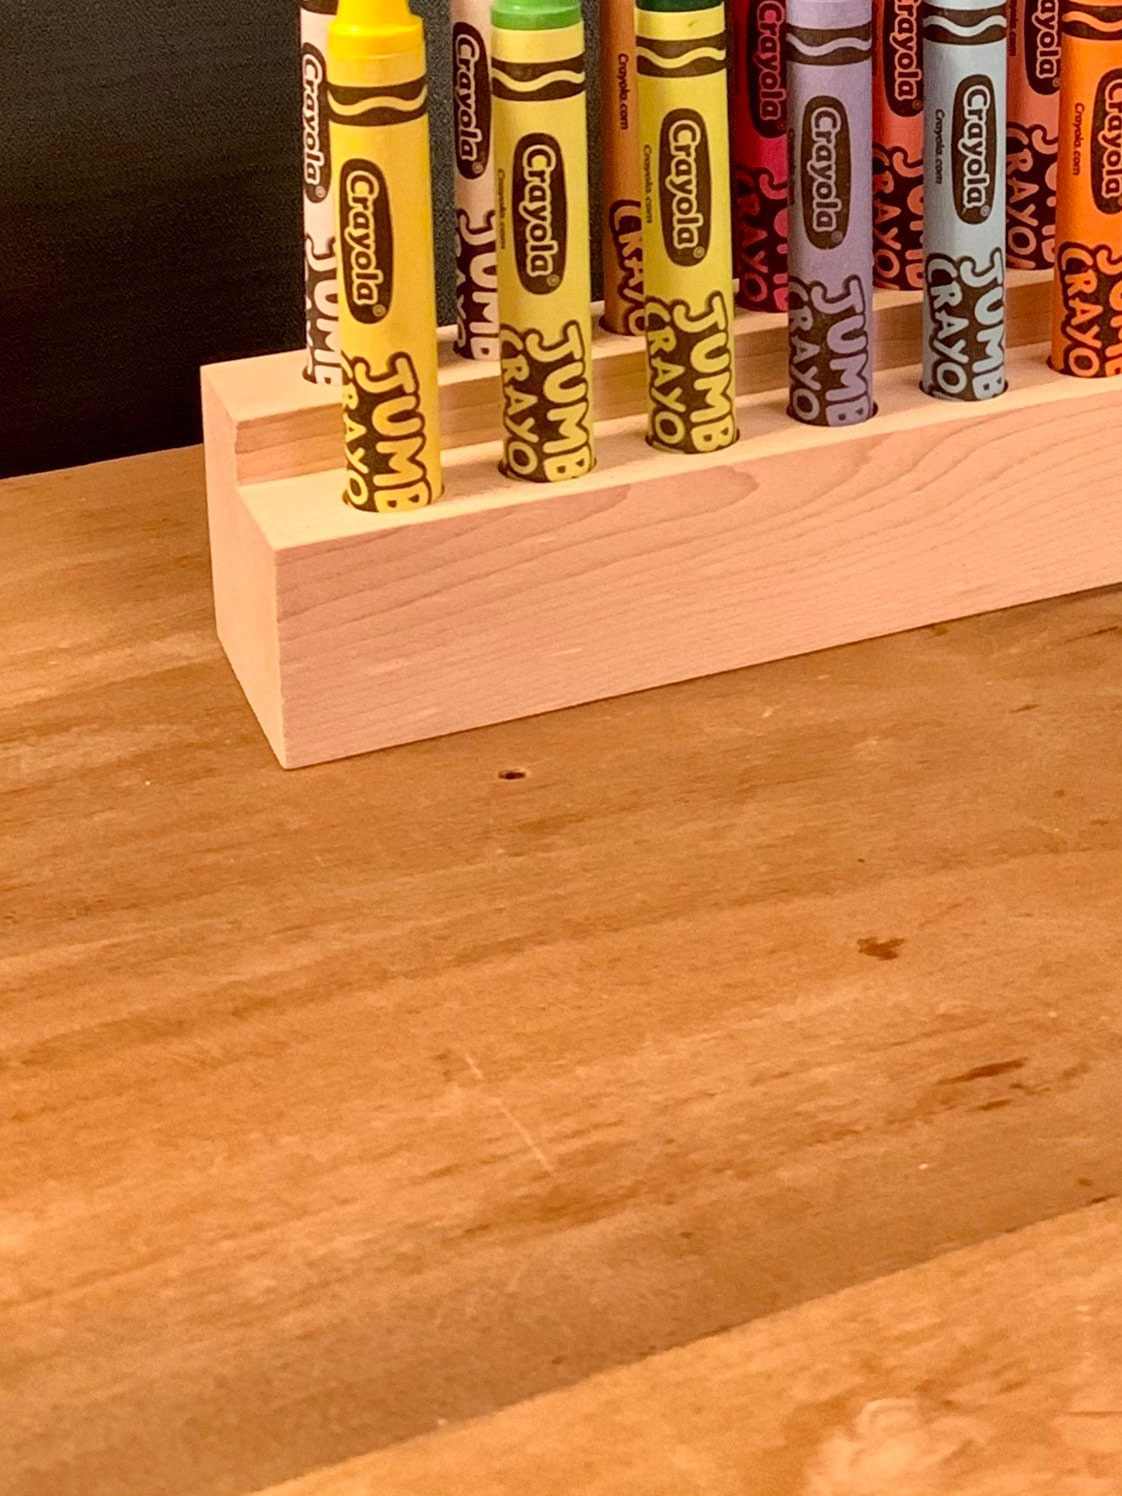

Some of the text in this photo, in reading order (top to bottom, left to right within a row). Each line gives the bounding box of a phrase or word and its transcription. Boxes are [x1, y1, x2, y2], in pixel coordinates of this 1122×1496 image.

[302, 53, 325, 185] Crayola
[455, 33, 482, 161] Crayola
[617, 53, 630, 130] Crayola.com
[754, 0, 787, 121] Crayola
[666, 119, 704, 250] Crayola
[807, 106, 842, 233] Crayola
[932, 108, 945, 184] Crayola.com
[958, 84, 990, 208] Crayola
[1072, 102, 1085, 176] Crayola.com
[346, 169, 384, 306] Crayola
[519, 143, 559, 278] Crayola
[1061, 248, 1103, 377] CRAYO
